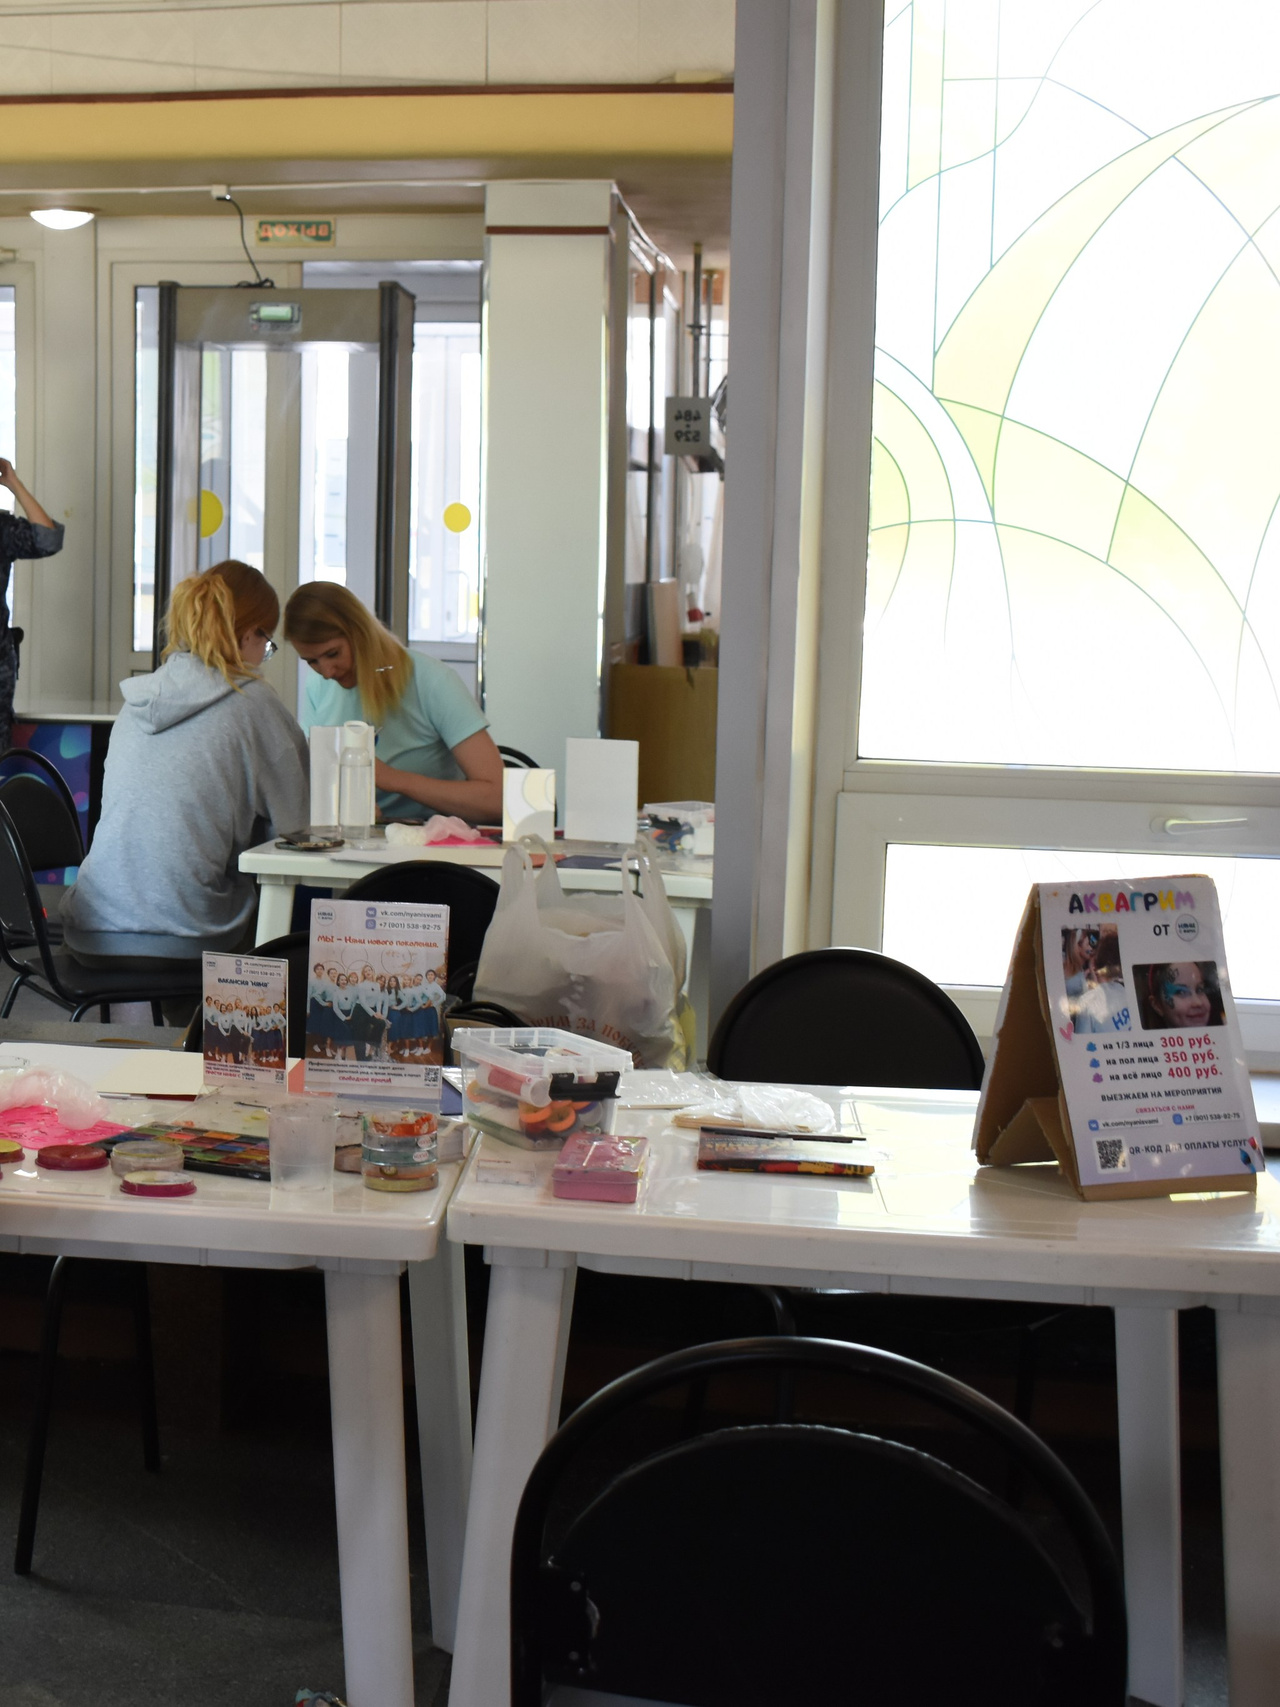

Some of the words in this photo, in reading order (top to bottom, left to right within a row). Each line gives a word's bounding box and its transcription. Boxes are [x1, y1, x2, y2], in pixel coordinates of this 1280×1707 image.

[1068, 889, 1196, 914] АКВАГРИМ
[381, 911, 442, 919] vk.com/nyanisvami
[1153, 924, 1170, 936] ОТ
[1103, 1042, 1113, 1050] на
[1116, 1041, 1130, 1050] 1/3
[1133, 1041, 1154, 1049] лица
[1160, 1036, 1184, 1048] 300
[1188, 1034, 1216, 1049] руб.
[1106, 1058, 1116, 1066] на
[1137, 1055, 1159, 1063] лица
[1164, 1051, 1188, 1063] 350
[1192, 1049, 1219, 1064] руб.
[1109, 1073, 1120, 1081] на
[1123, 1071, 1138, 1080] всё
[1141, 1071, 1162, 1080] лицо
[1168, 1066, 1191, 1078] 400
[1195, 1064, 1223, 1079] руб.
[1101, 1090, 1149, 1102] ВЫЕЗЖАЕМ
[1151, 1090, 1162, 1098] НА
[1164, 1087, 1222, 1098] МЕРОПРИЯТИЯ
[1135, 1105, 1170, 1114] СВЯЗАТЬСЯ
[1129, 1144, 1162, 1155] QR-КОД
[1185, 1141, 1220, 1151] ОПЛАТЫ
[1222, 1138, 1248, 1148] УСЛУГ
